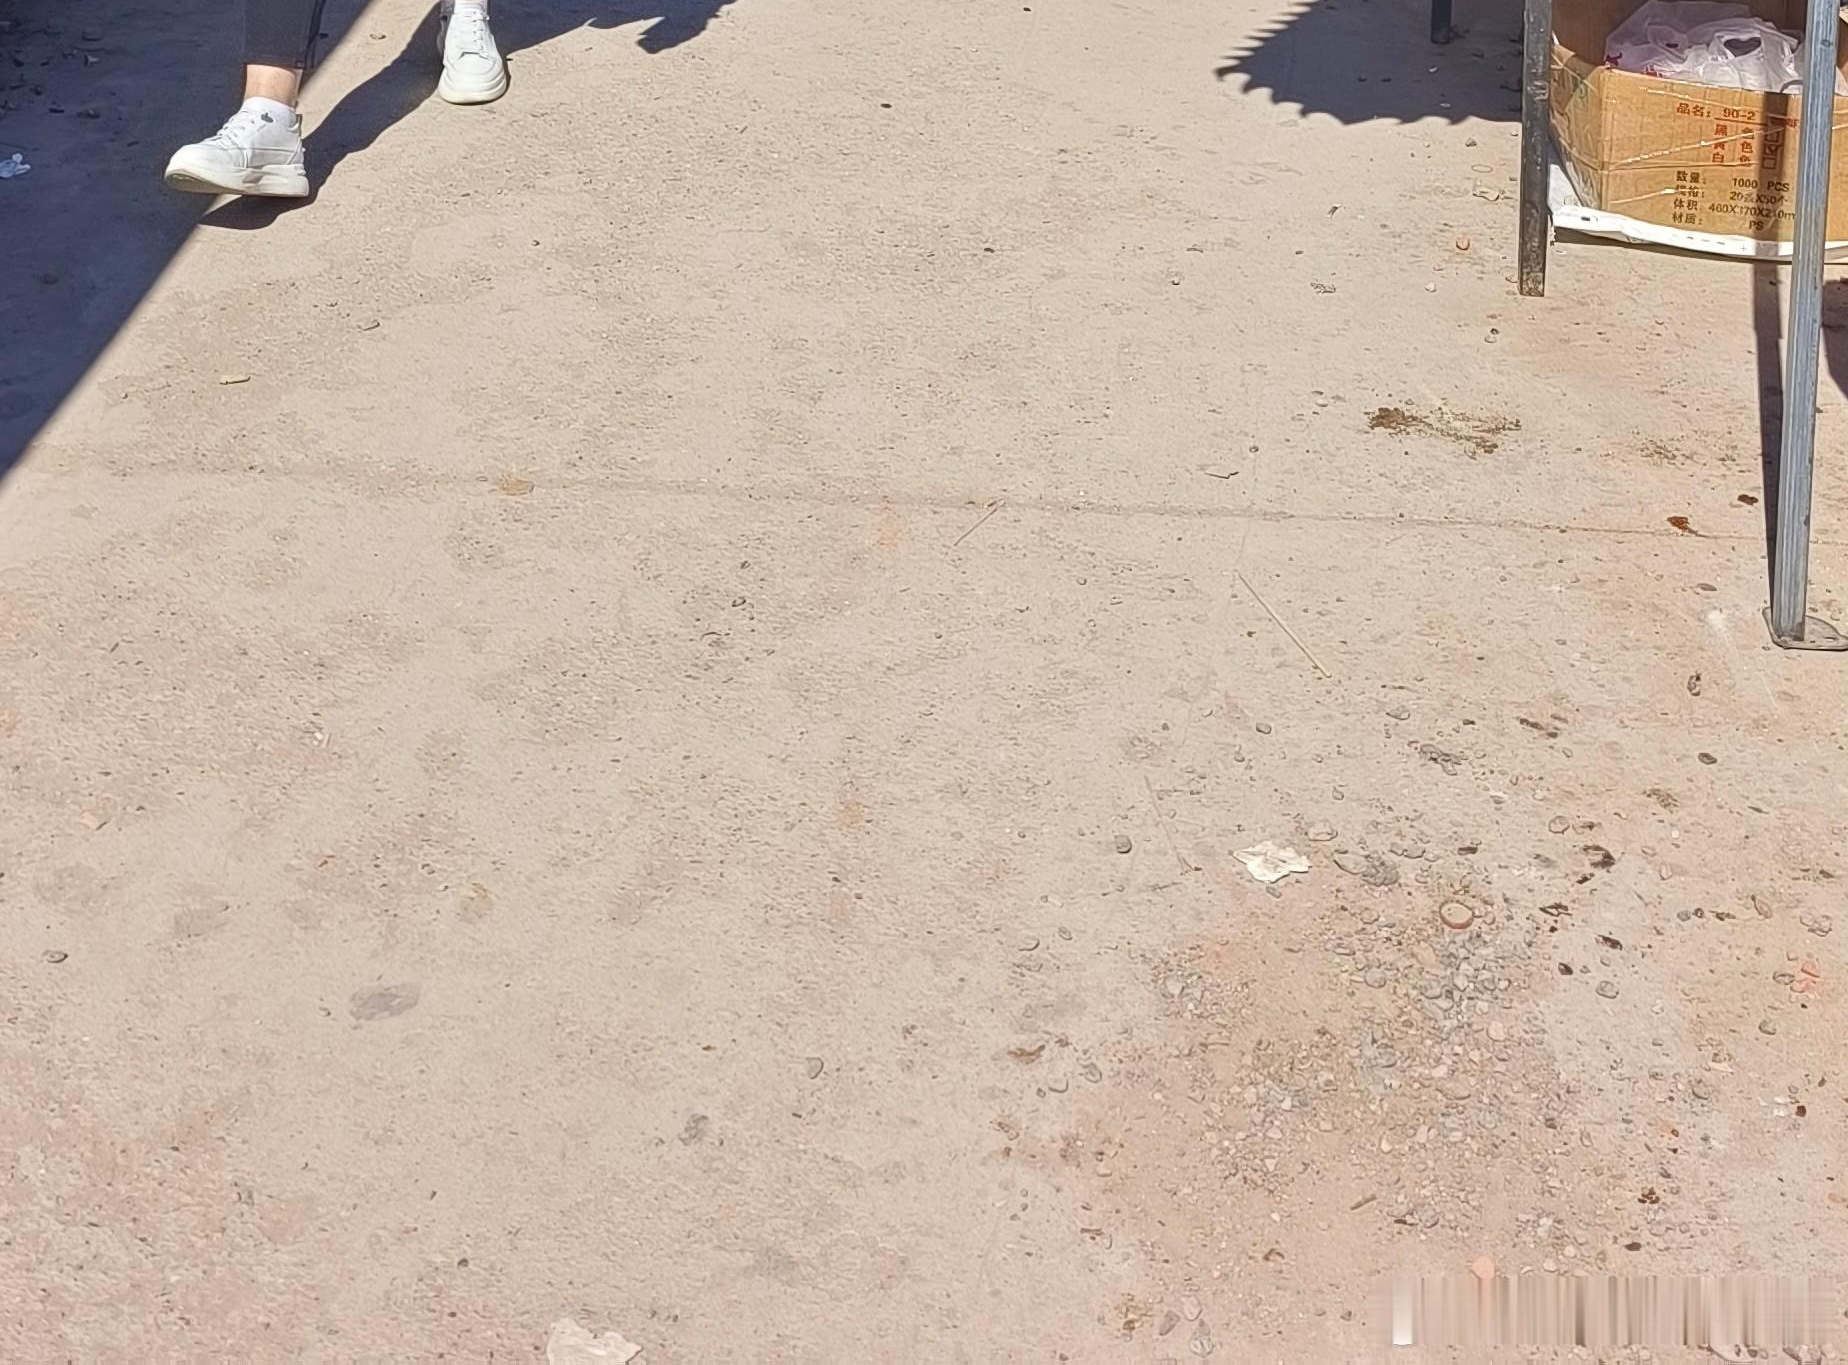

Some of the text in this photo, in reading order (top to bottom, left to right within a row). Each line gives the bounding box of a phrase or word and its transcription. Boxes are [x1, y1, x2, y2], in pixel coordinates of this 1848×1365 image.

[1723, 108, 1756, 120] 90-2
[1733, 177, 1758, 189] 1000
[1767, 180, 1790, 193] PCS
[1748, 220, 1764, 231] PS
